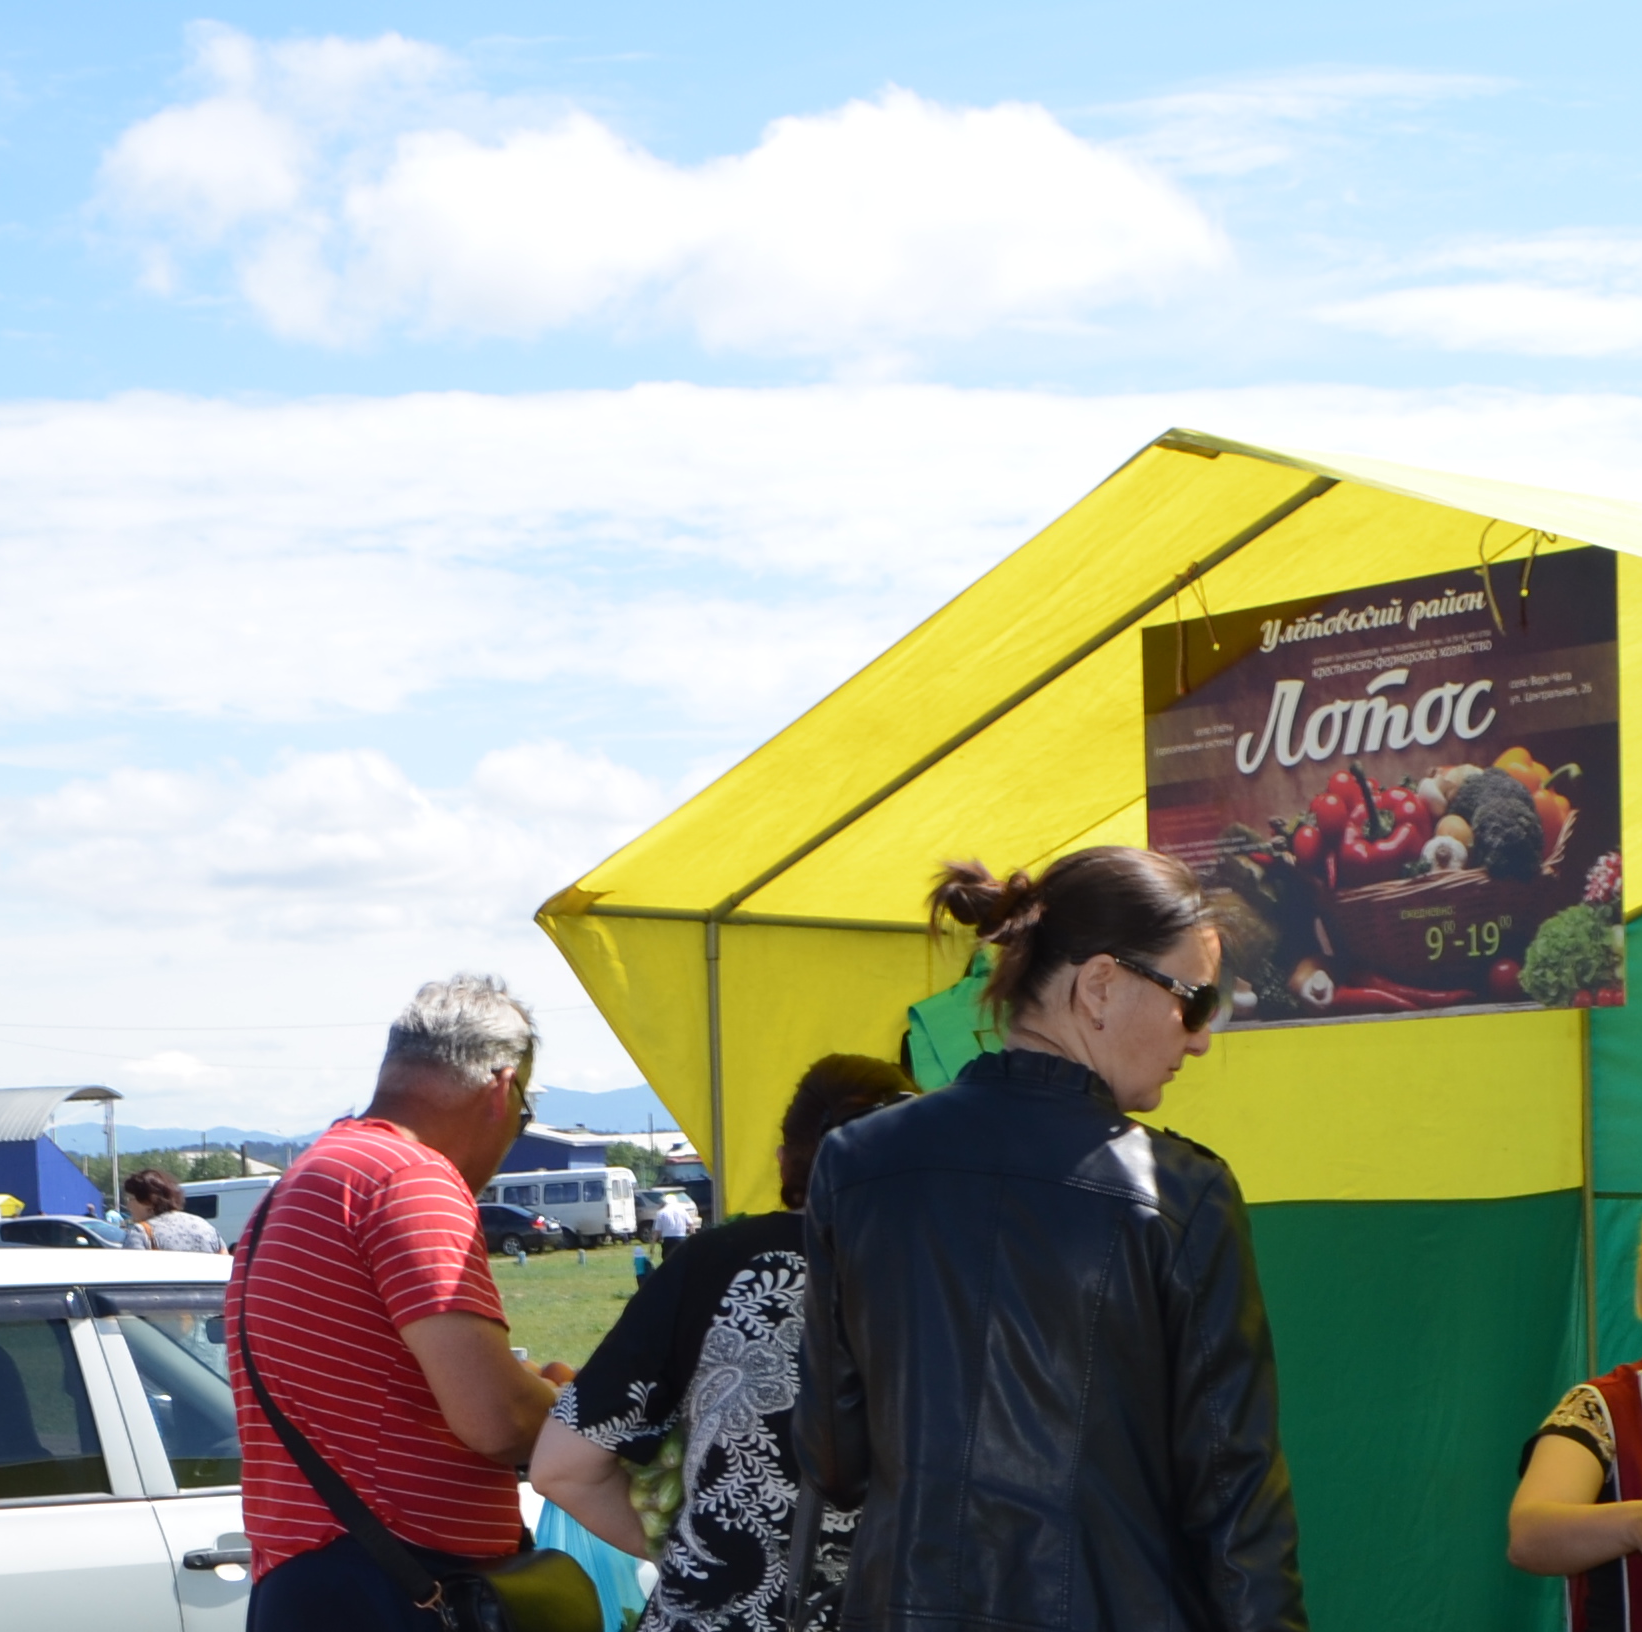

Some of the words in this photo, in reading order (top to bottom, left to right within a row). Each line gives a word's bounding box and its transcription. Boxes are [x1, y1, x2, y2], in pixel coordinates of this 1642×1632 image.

[1259, 598, 1404, 653] Улётовский
[1408, 588, 1488, 631] район
[1235, 668, 1496, 775] Лотос
